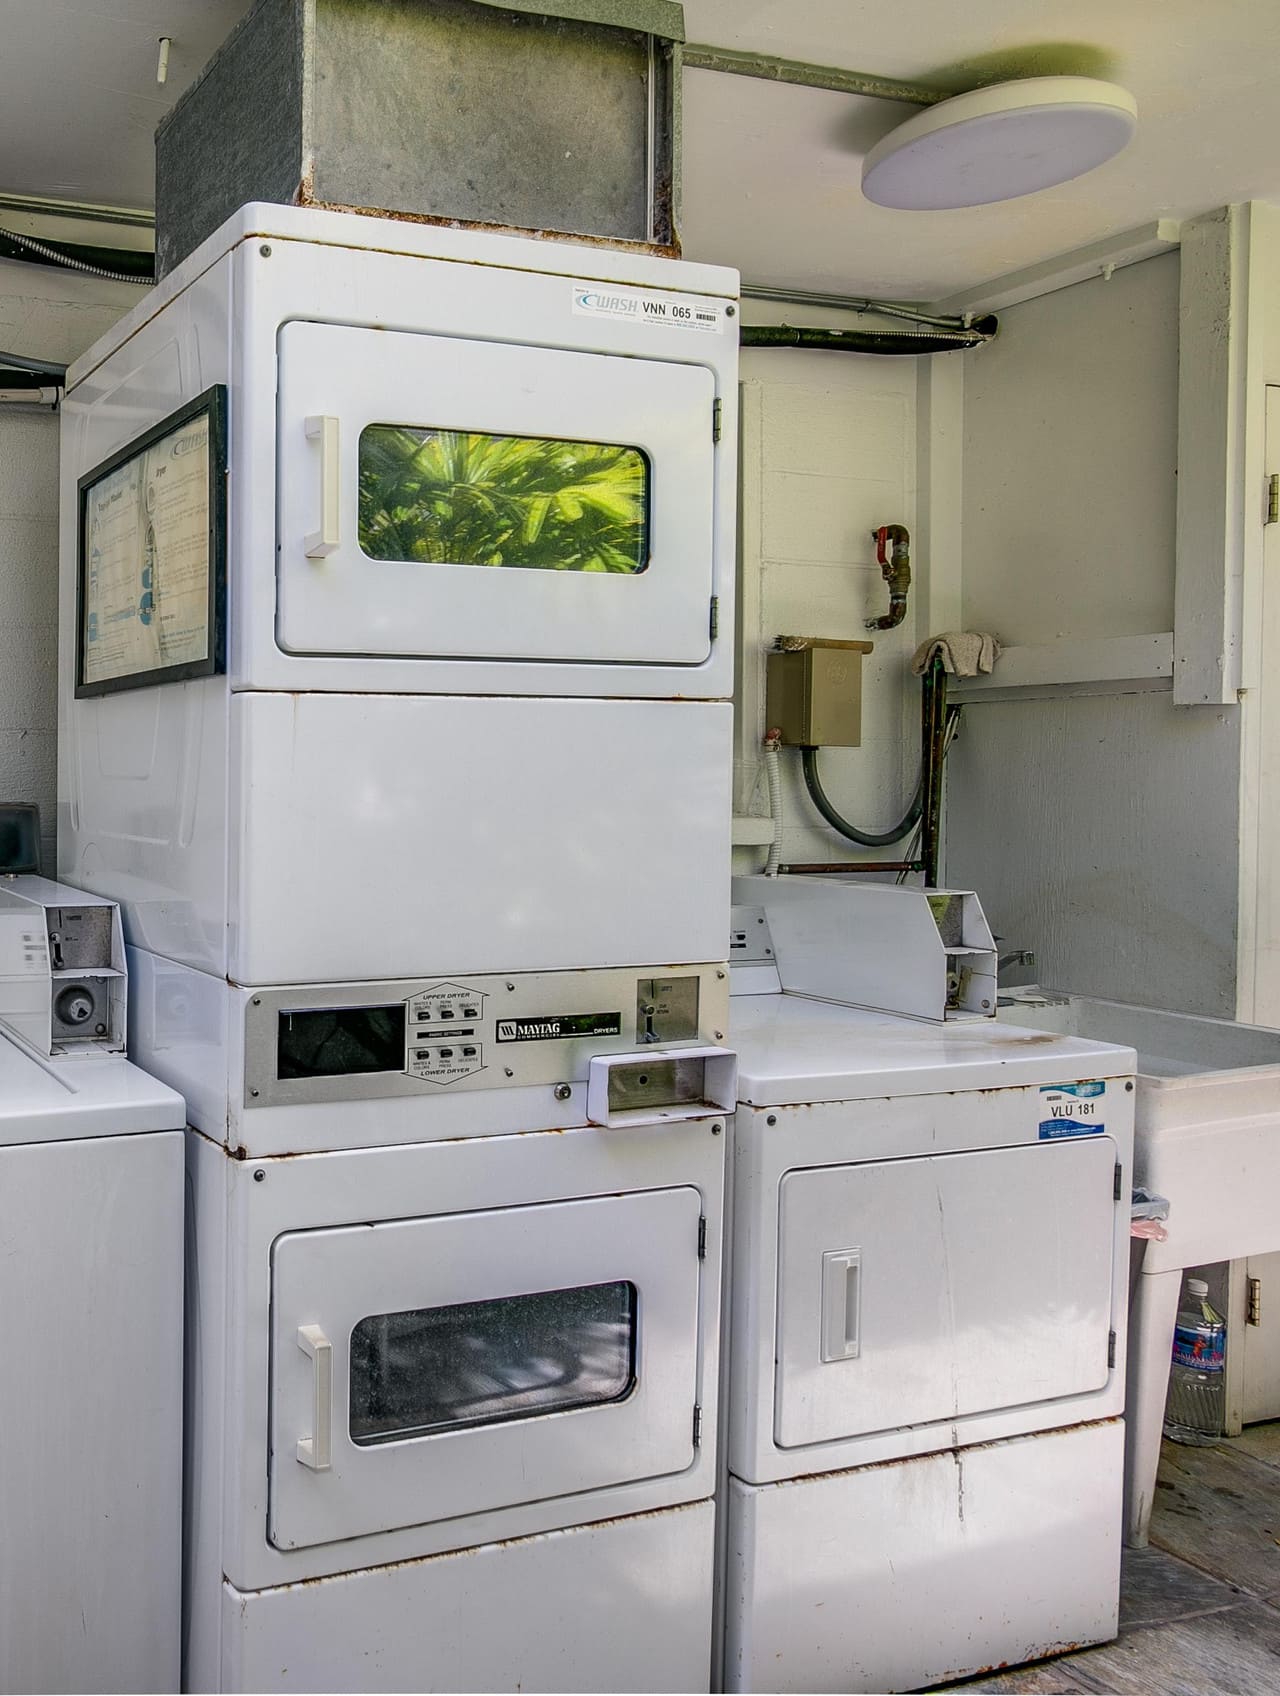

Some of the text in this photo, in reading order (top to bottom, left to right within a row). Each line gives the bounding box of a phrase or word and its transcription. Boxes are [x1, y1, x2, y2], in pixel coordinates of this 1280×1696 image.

[595, 295, 638, 313] WASH
[642, 301, 666, 315] VNN
[672, 306, 691, 319] 065
[517, 1022, 560, 1035] MAYTAG
[1051, 1103, 1095, 1117] VLU 181
